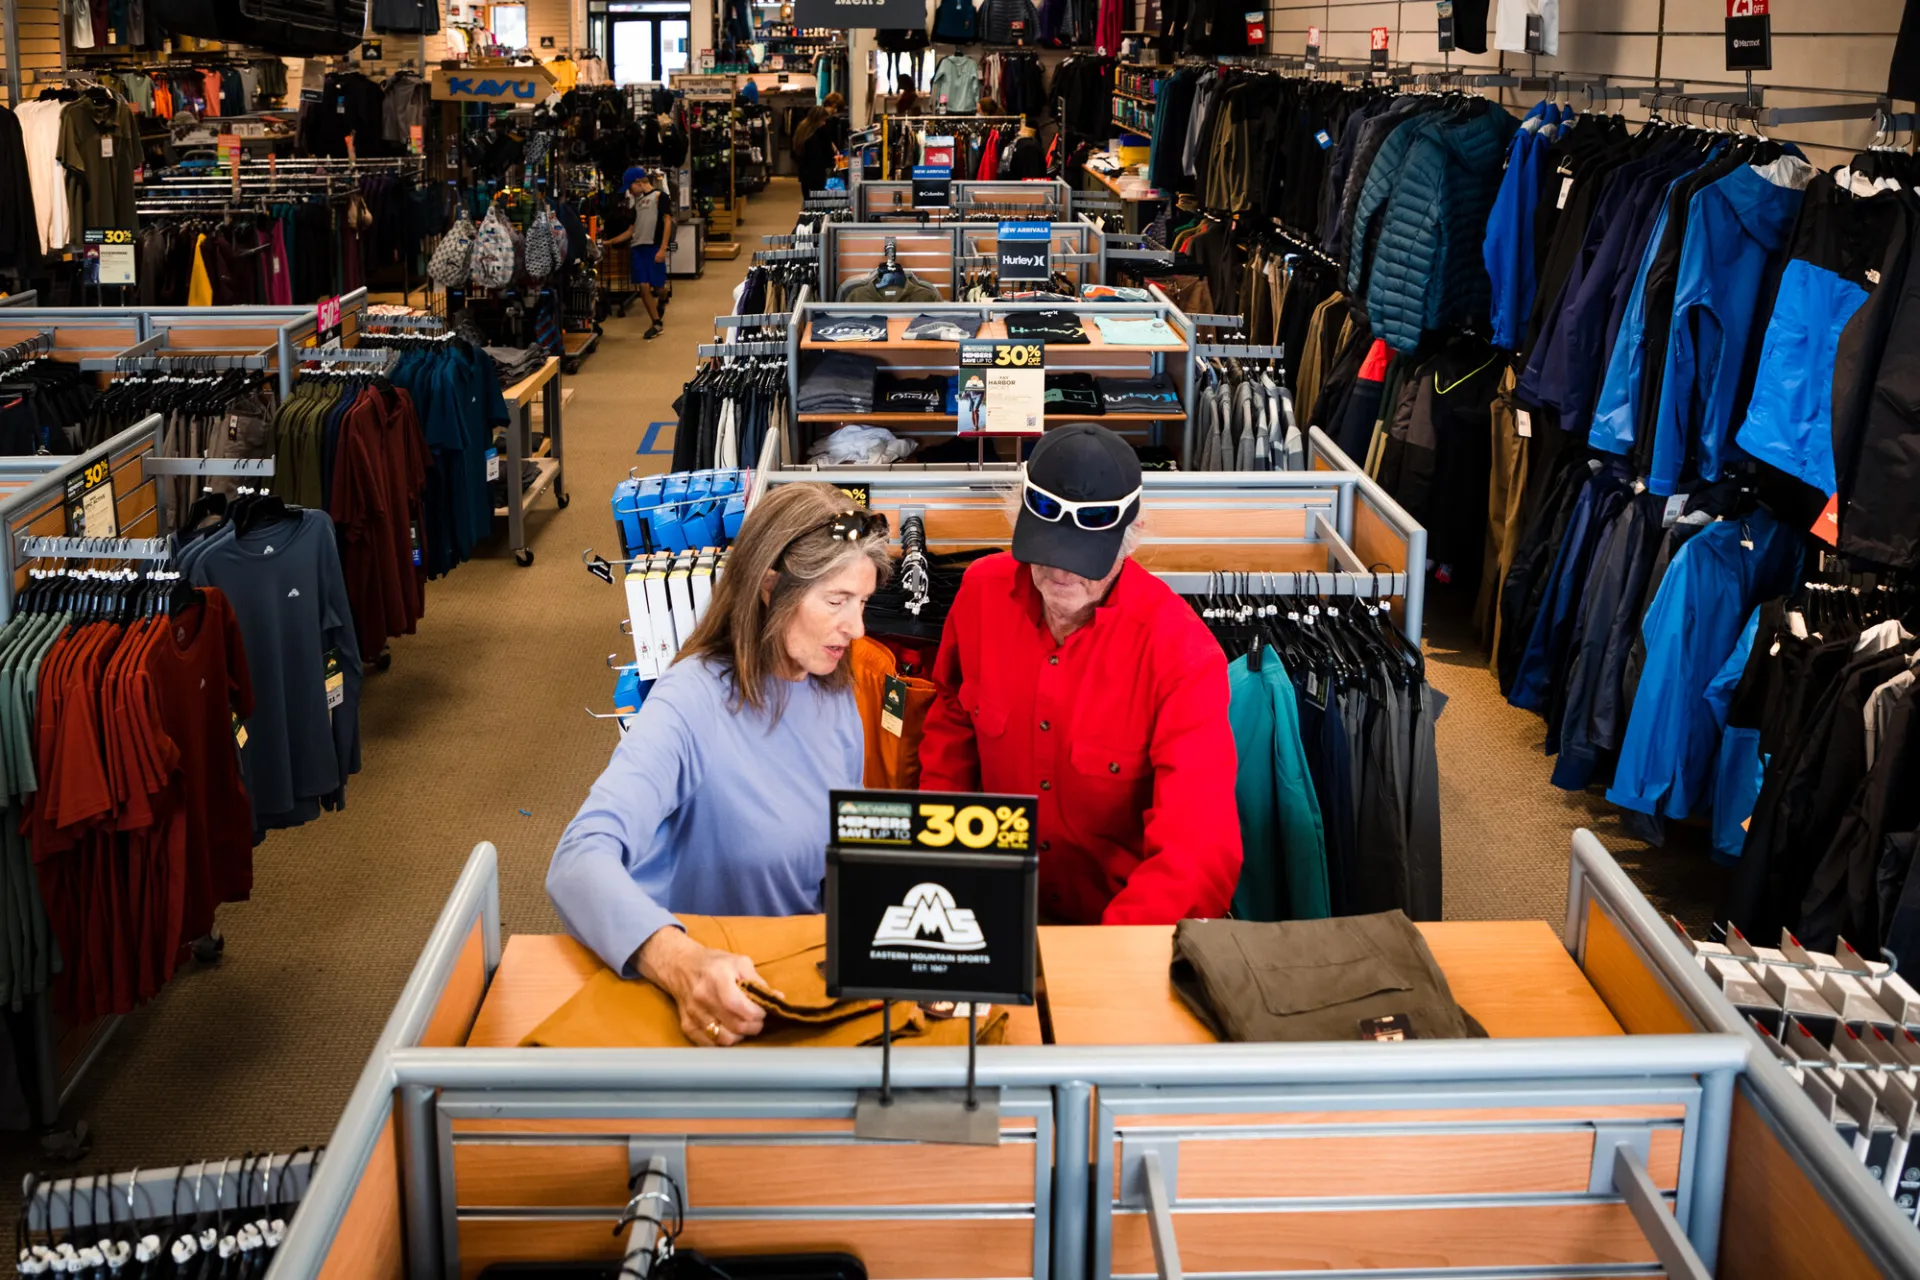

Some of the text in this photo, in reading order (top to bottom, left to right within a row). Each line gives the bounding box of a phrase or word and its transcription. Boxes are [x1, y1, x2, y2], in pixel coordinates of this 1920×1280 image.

[1753, 5, 1764, 14] OFF
[1739, 39, 1760, 47] Marmot
[449, 77, 535, 98] KAVU
[104, 229, 132, 243] 30%
[1003, 255, 1033, 266] Hurley
[994, 345, 1041, 366] 30%
[84, 459, 108, 489] 30%
[838, 815, 911, 829] MEMBERS
[916, 804, 1030, 849] 30%
[838, 828, 1029, 844] SAVE UP TO OFF
[874, 893, 985, 945] EMS
[869, 950, 990, 965] EASTERN MOUNTAIN SPORTS
[911, 963, 928, 973] EST.
